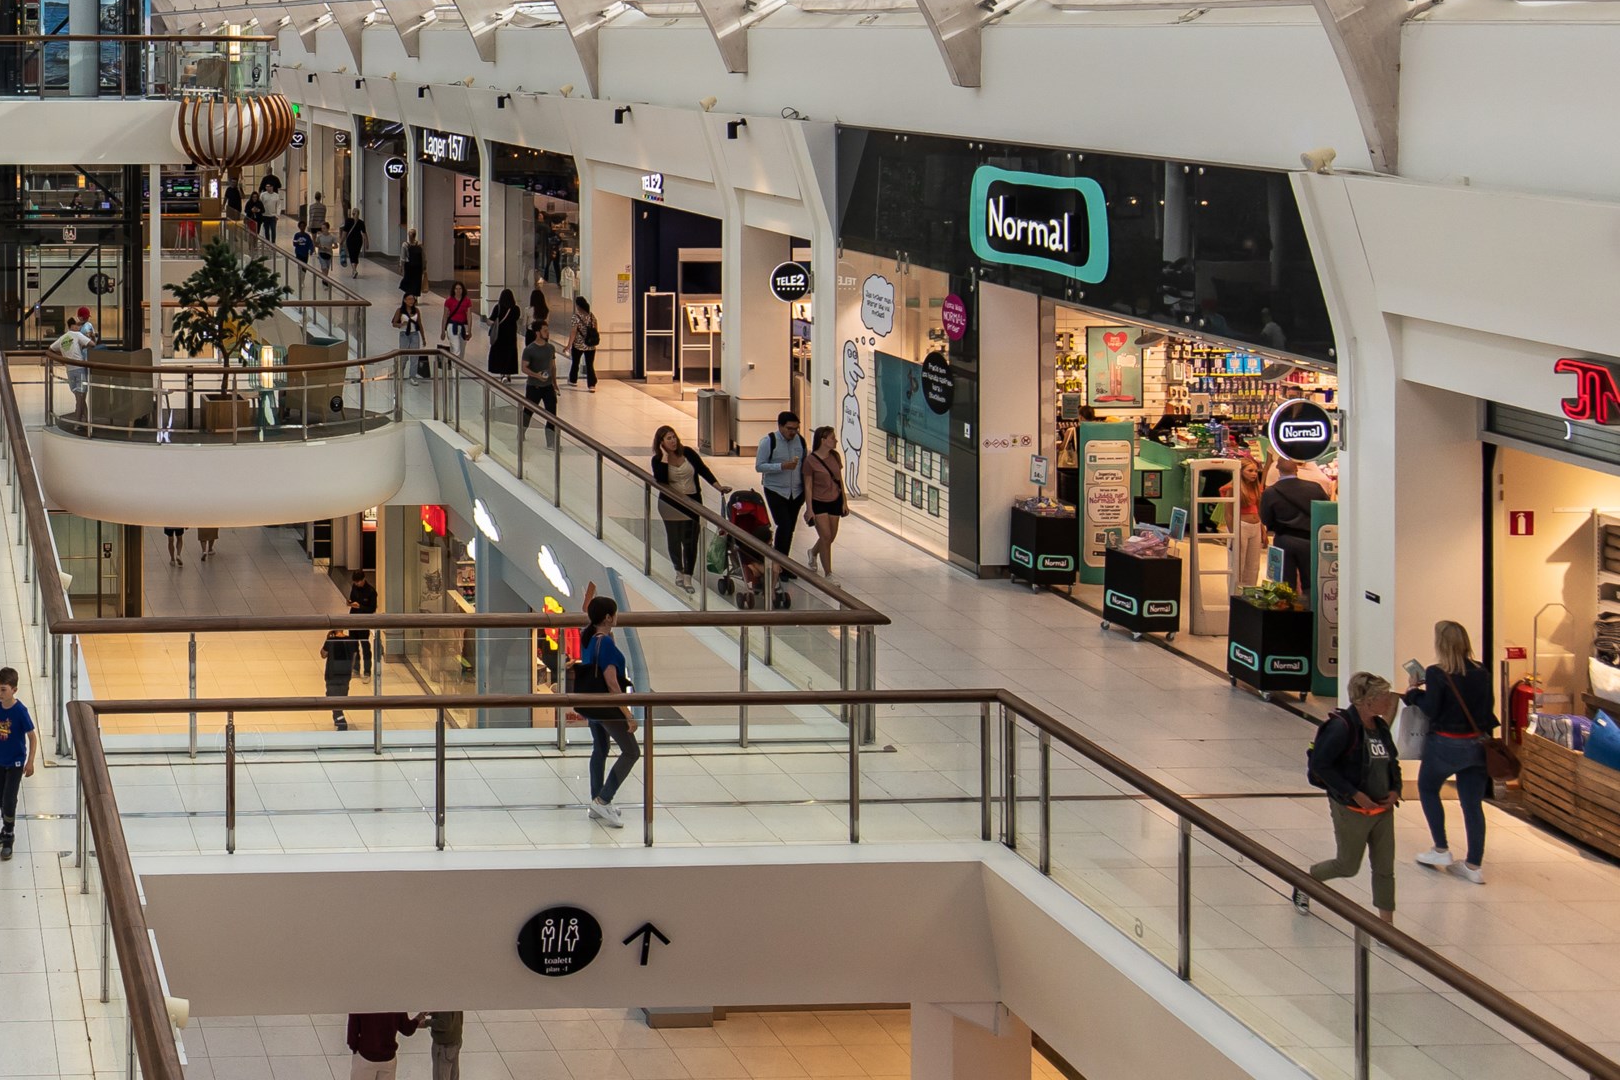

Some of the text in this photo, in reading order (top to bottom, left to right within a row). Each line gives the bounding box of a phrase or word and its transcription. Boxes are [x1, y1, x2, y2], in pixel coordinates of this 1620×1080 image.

[423, 129, 464, 162] Lager 157
[641, 173, 662, 194] TELE2
[989, 195, 1070, 253] Normal
[776, 274, 805, 286] TELE2
[1285, 426, 1320, 438] Normal
[1112, 596, 1131, 609] Normal
[1235, 648, 1253, 664] Normal
[1273, 661, 1300, 670] Normal
